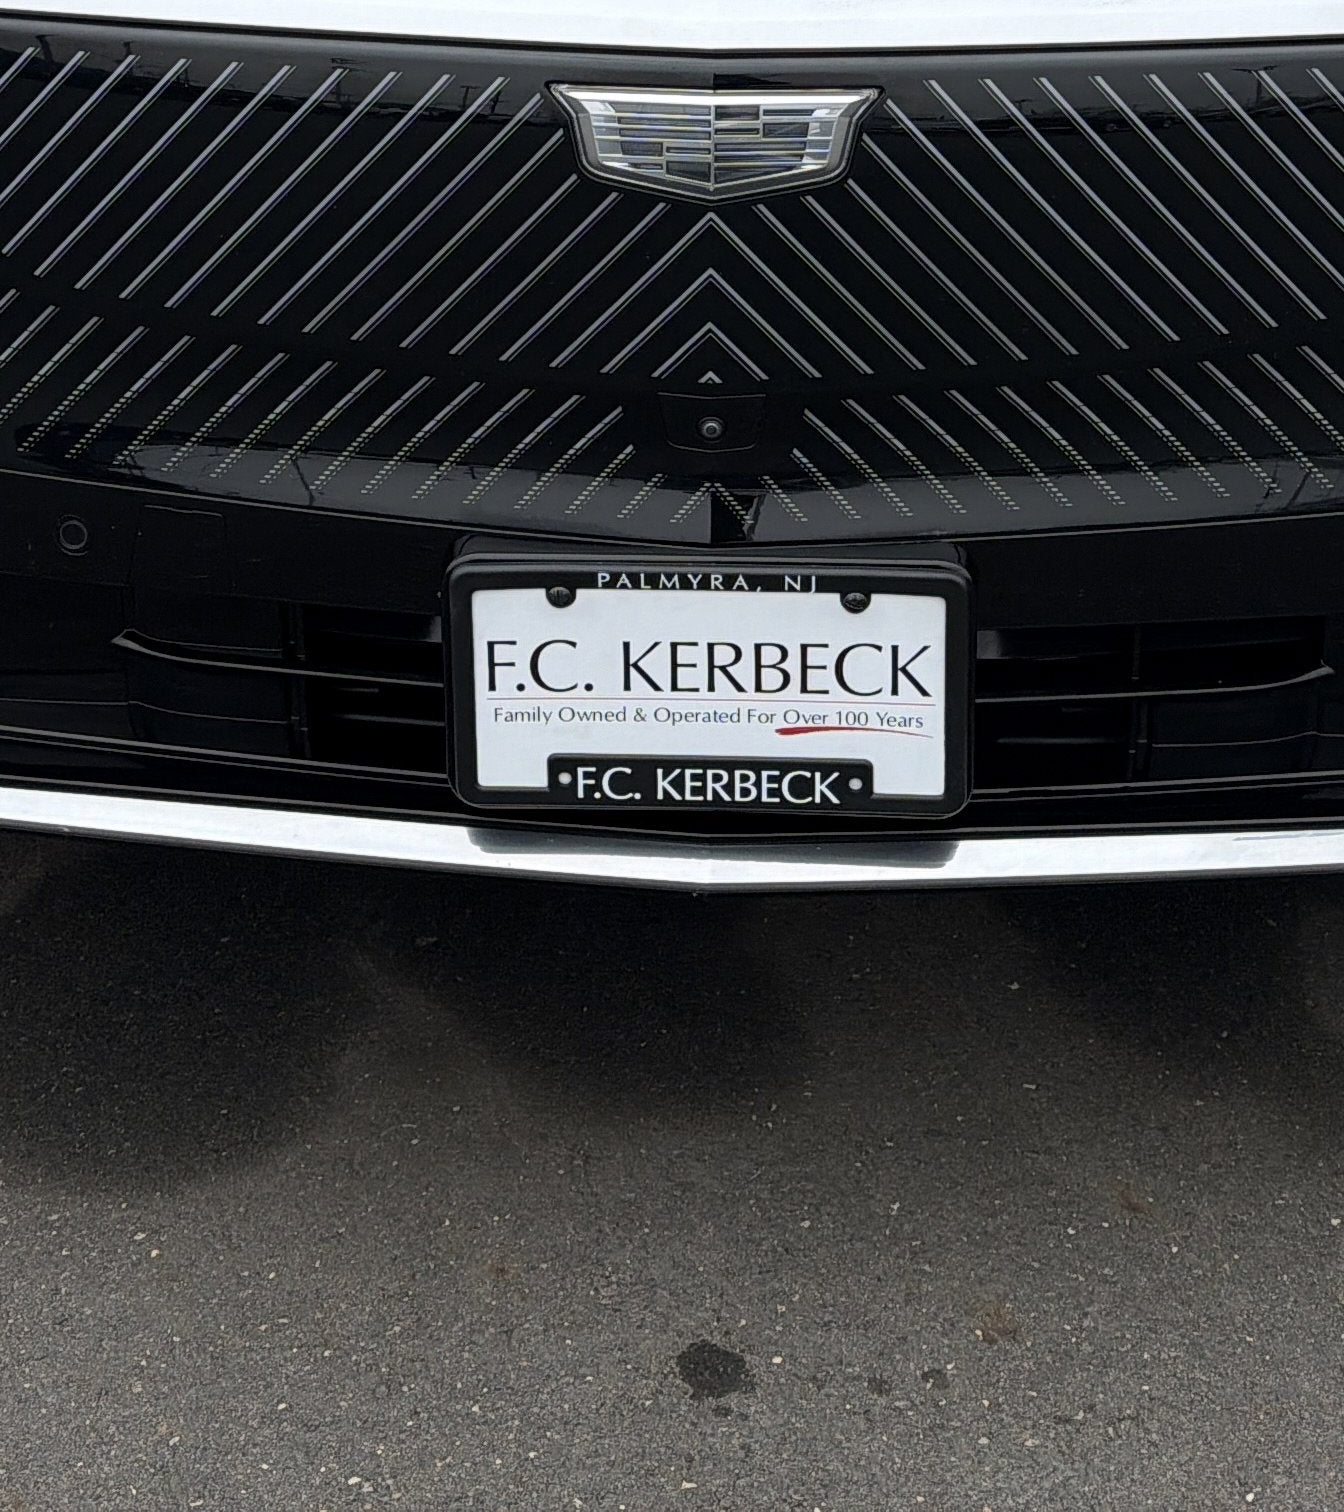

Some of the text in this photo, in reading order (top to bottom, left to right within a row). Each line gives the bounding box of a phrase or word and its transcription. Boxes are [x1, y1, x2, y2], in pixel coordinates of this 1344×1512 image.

[597, 572, 816, 594] PALMYRA, NJ
[486, 640, 933, 698] F.C. KERBECK
[494, 706, 924, 729] Family Owned & Operated For Over 100 Years
[576, 766, 841, 805] F.C. KERBECK
